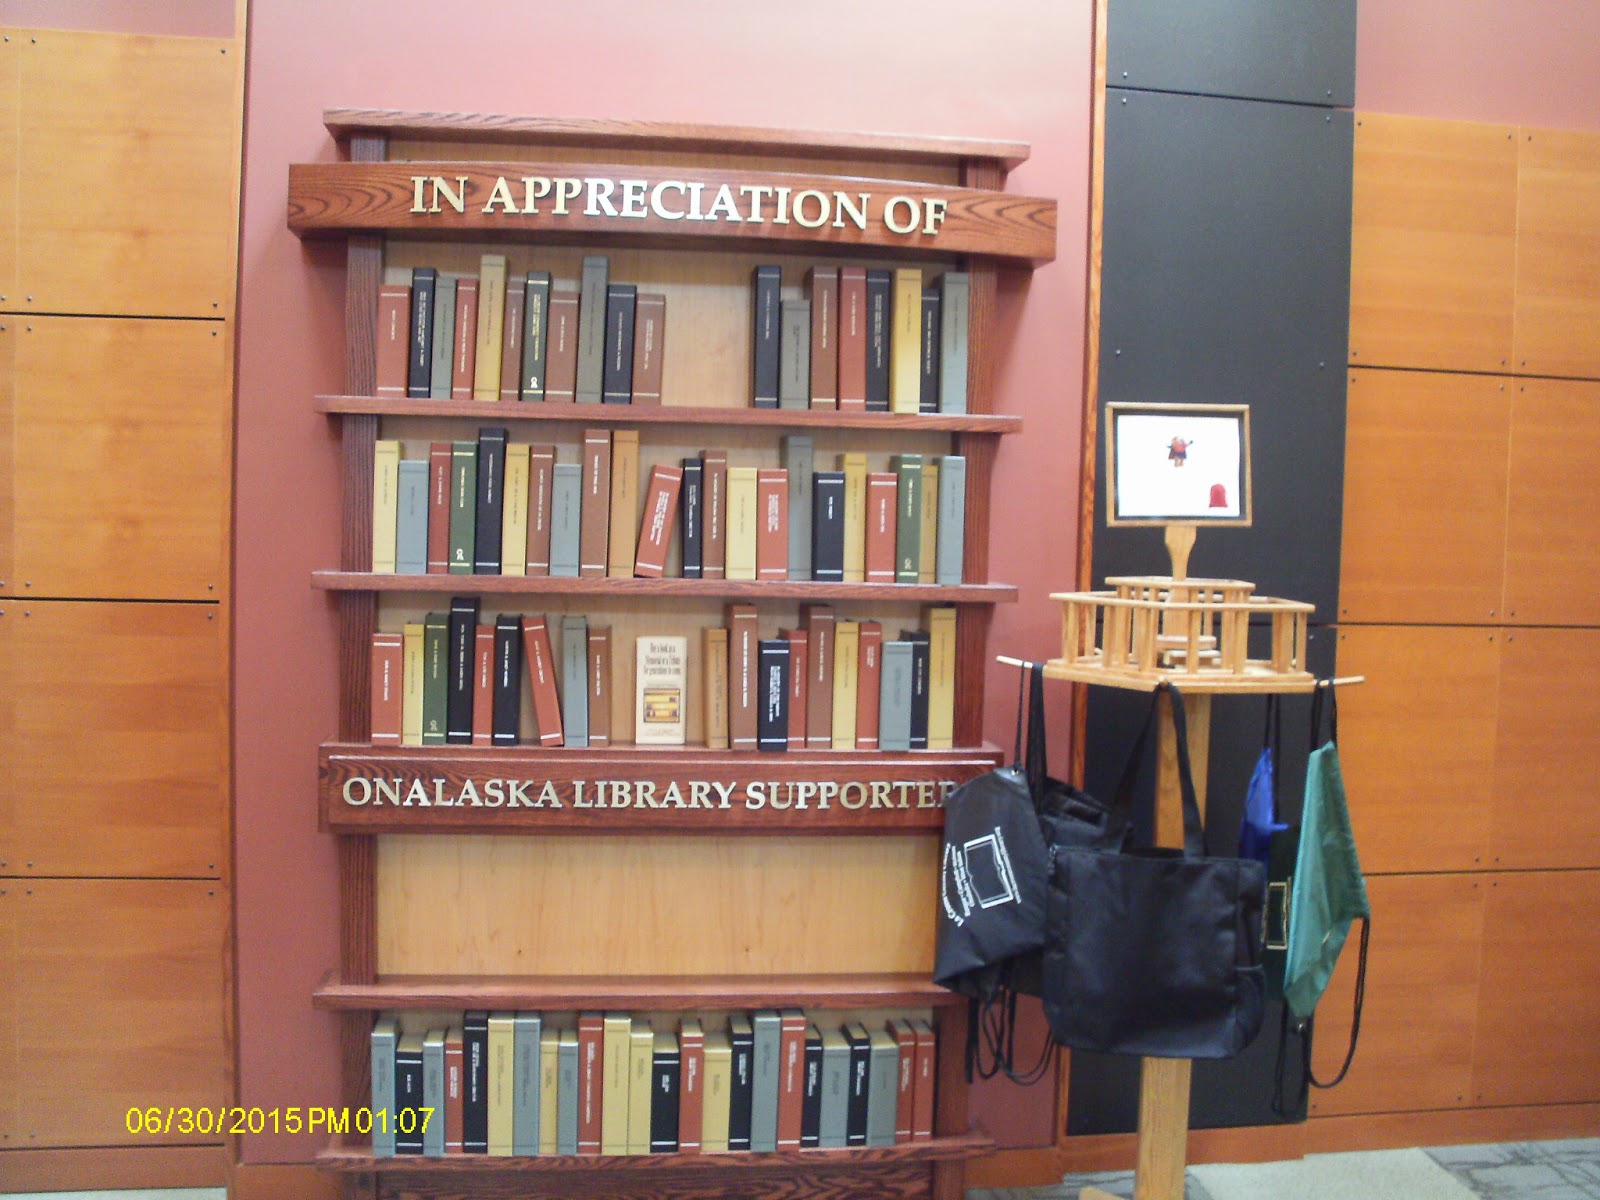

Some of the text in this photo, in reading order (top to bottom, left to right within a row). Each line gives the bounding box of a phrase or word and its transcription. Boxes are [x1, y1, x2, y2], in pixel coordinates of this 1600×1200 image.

[409, 175, 949, 236] IN APPRECIATION OF
[342, 777, 563, 809] ONALASKA
[572, 780, 737, 810] LIBRARY
